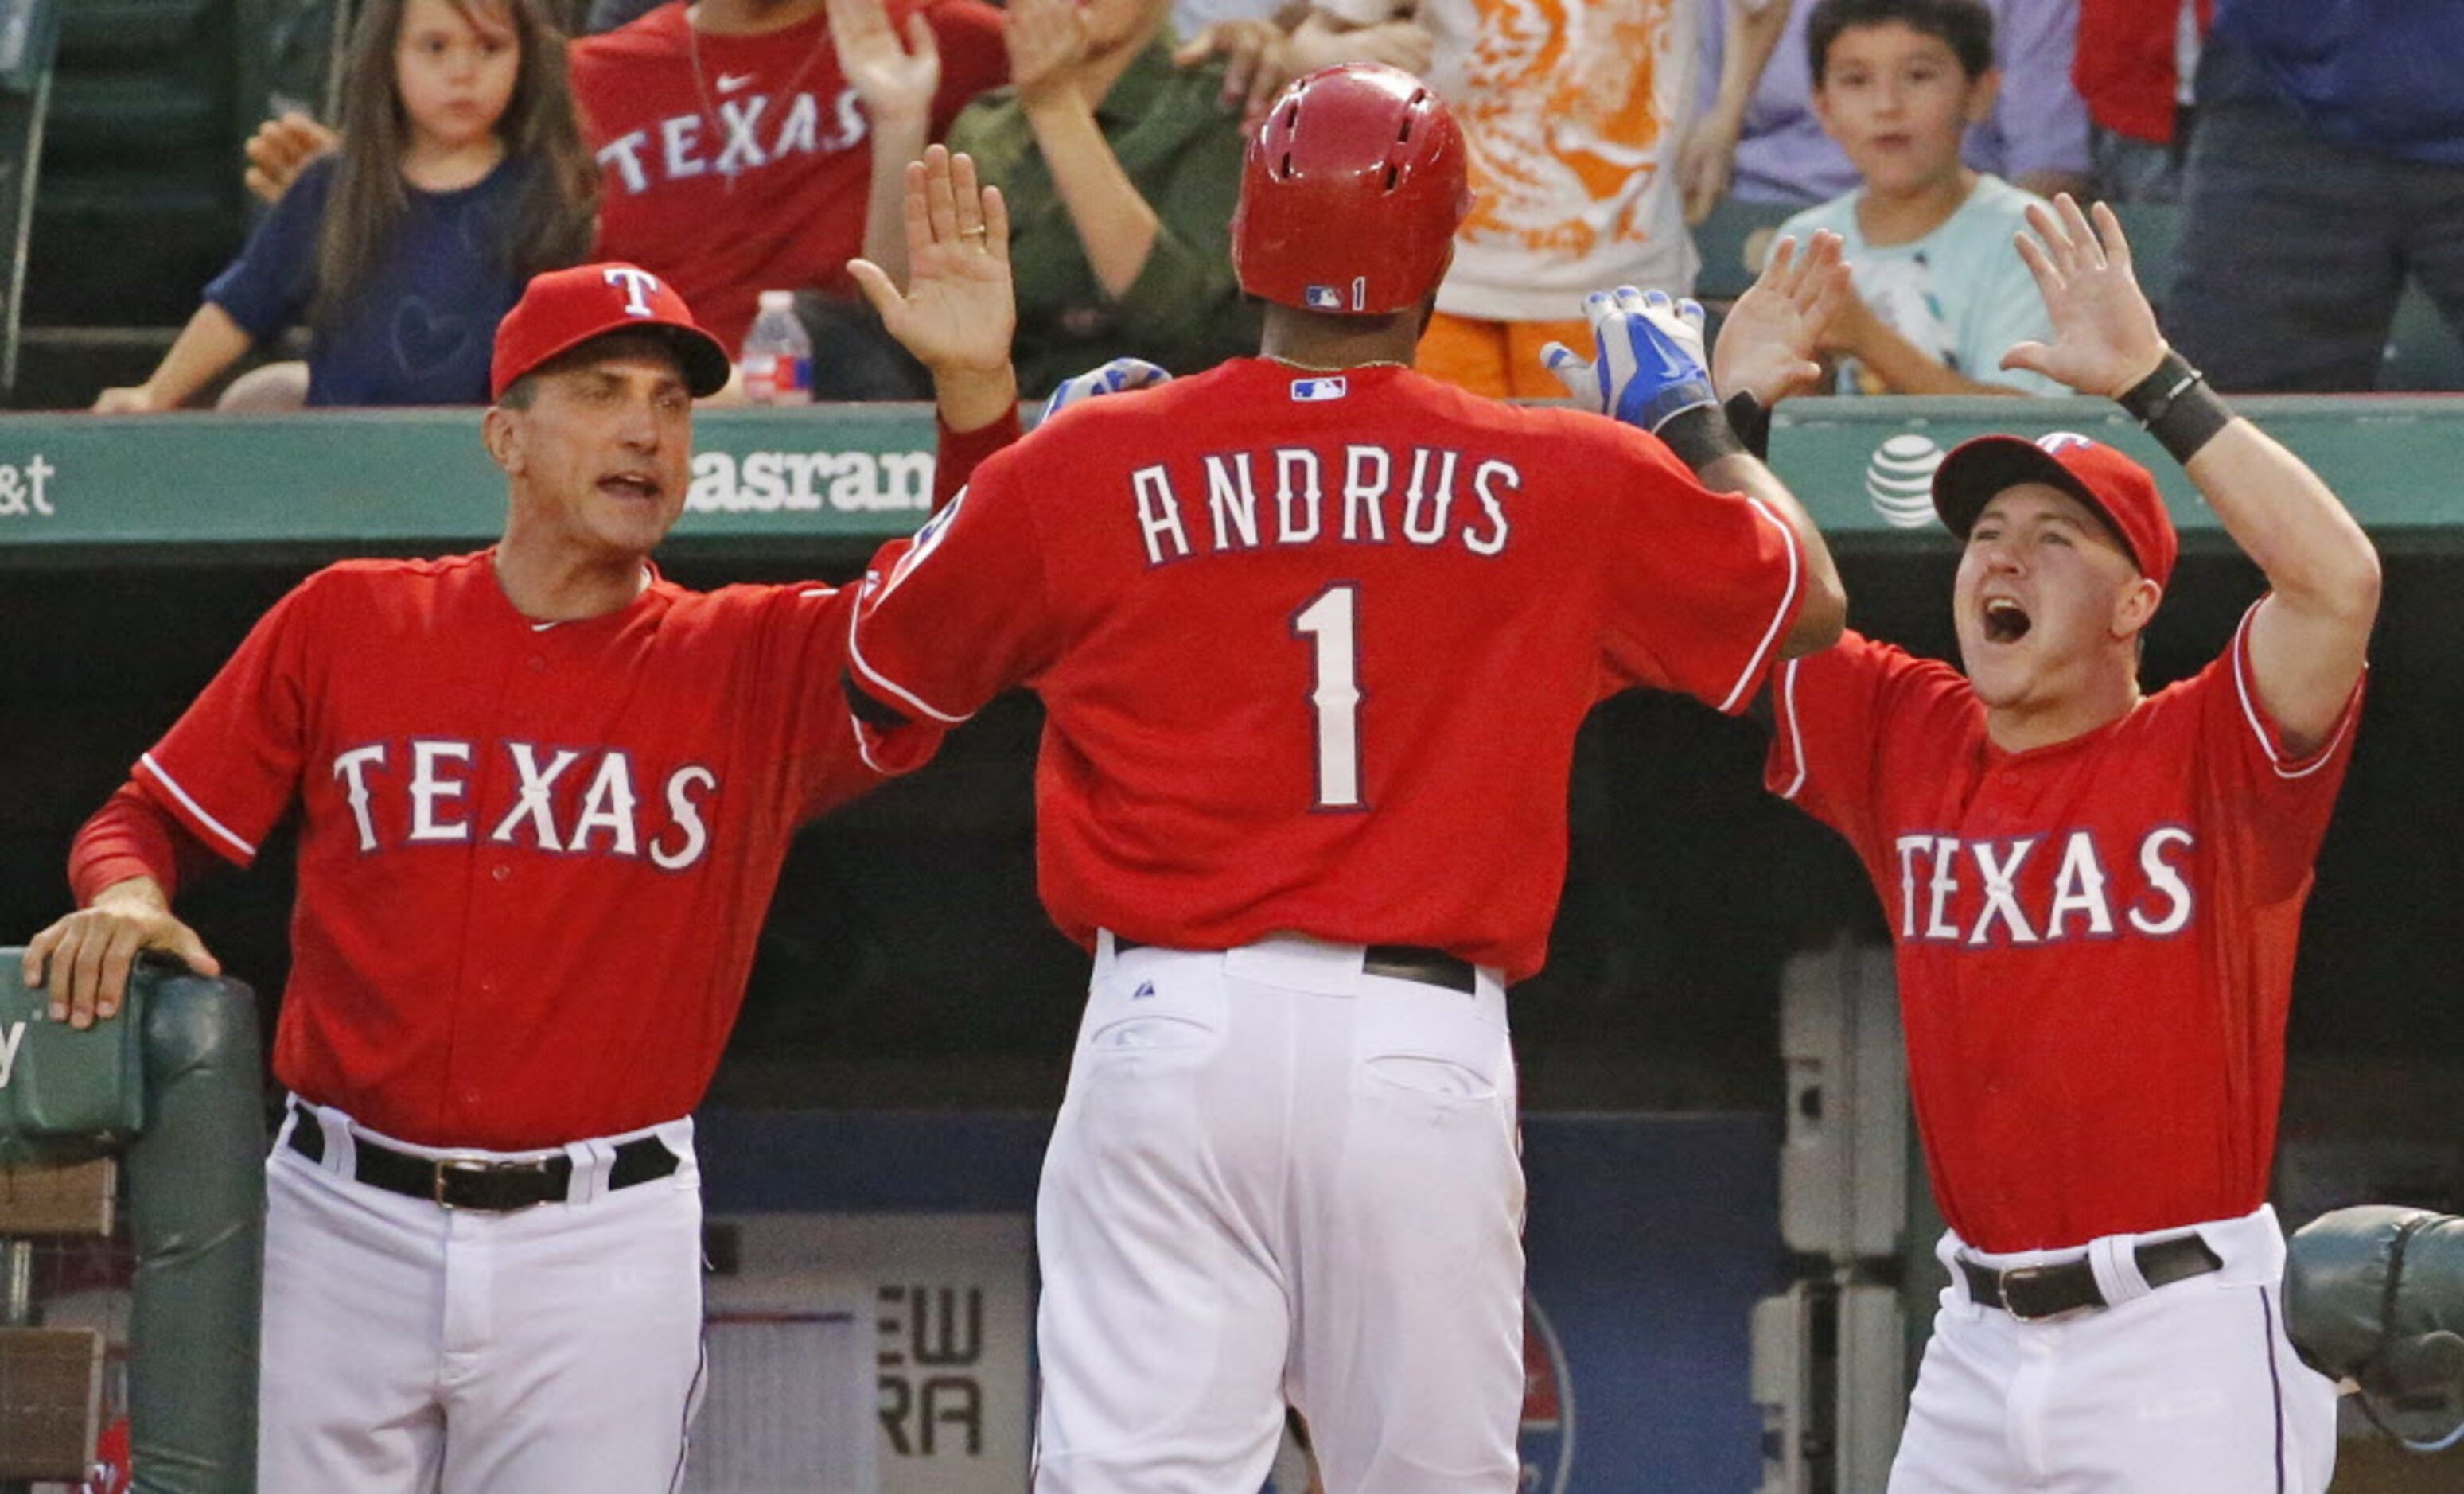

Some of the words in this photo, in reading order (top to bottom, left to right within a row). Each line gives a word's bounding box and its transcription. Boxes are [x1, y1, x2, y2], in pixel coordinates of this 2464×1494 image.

[596, 88, 869, 193] TEXAS
[602, 267, 659, 317] T
[1352, 276, 1366, 311] 1
[0, 454, 55, 516] &t
[683, 451, 936, 512] asran
[1130, 444, 1522, 566] ANDRUS
[1293, 581, 1368, 811] 1
[332, 738, 718, 872] TEXAS
[1894, 826, 2197, 947] TEXAS
